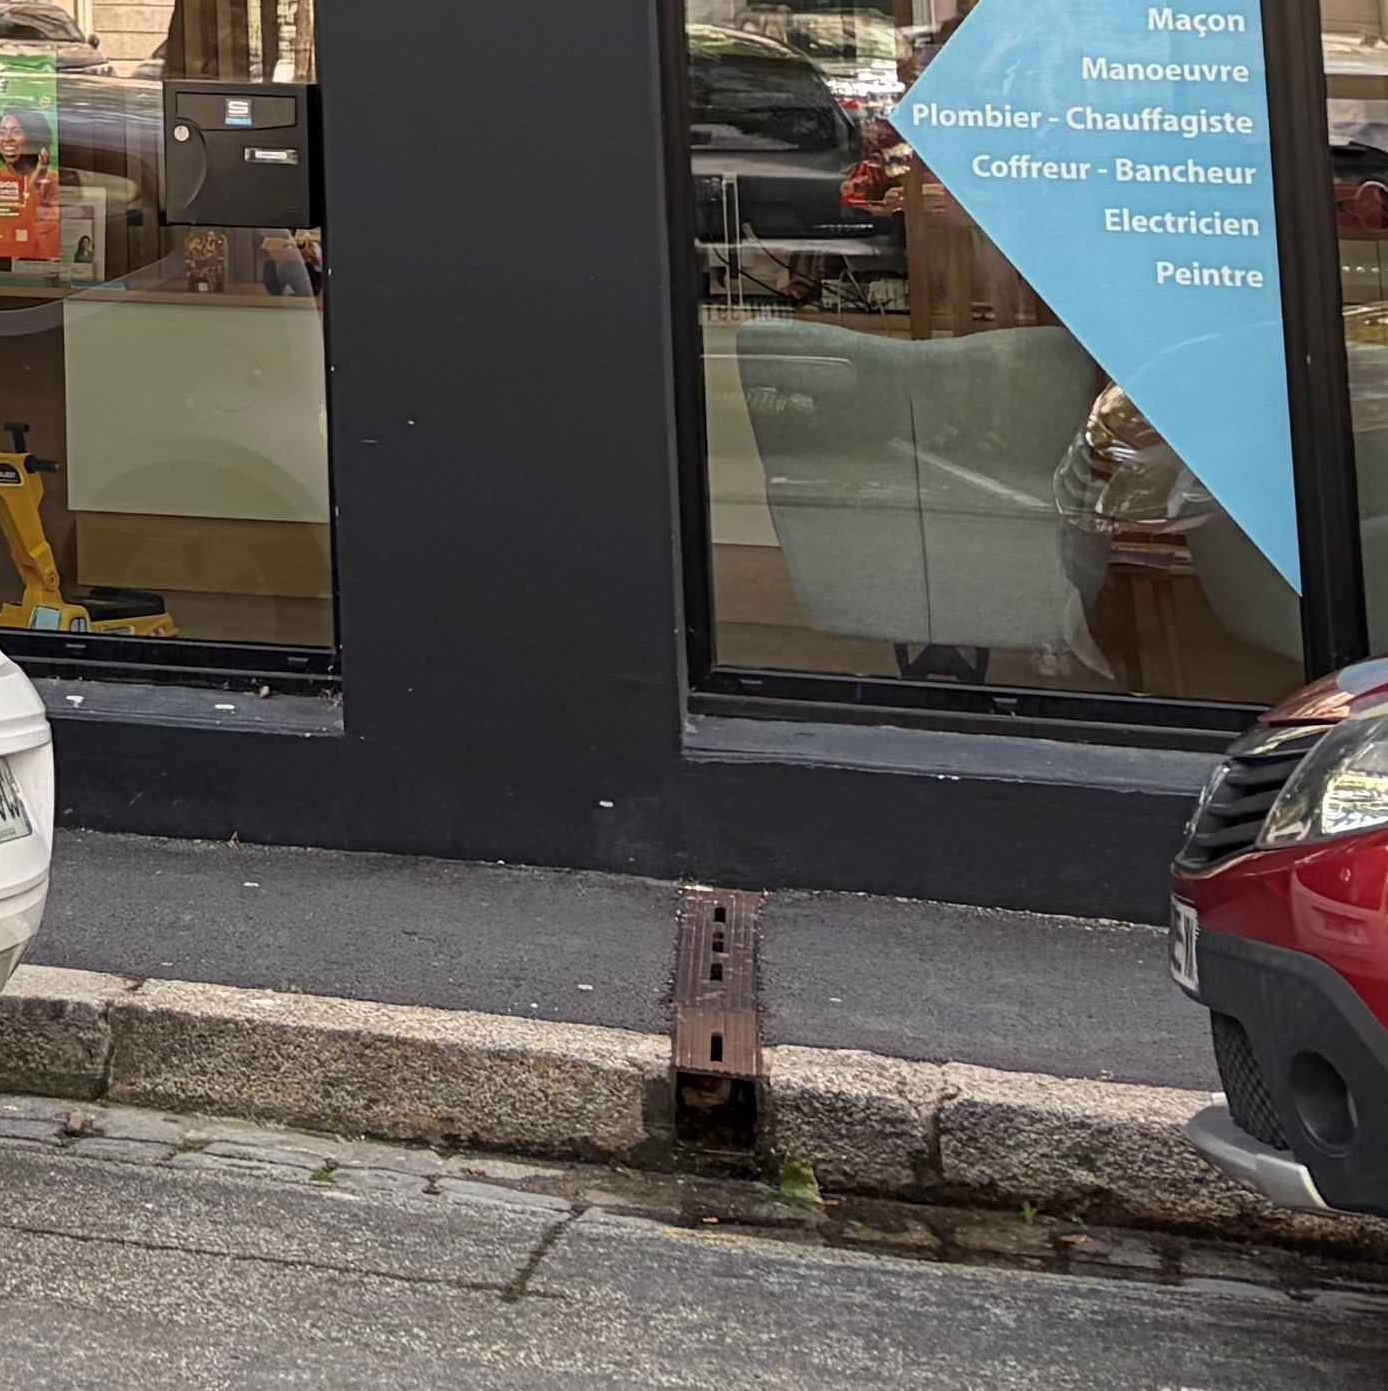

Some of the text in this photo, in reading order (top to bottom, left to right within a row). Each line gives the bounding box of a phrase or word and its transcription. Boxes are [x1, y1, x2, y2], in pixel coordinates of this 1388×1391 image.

[1147, 6, 1246, 38] Maçon
[1081, 56, 1250, 84] Manoeuvre
[912, 104, 1043, 129] Plombier
[1065, 105, 1254, 139] Chauffagiste
[971, 154, 1092, 181] Coffreur
[1115, 158, 1257, 185] Bancheur
[1104, 208, 1260, 237] Electricien
[1156, 261, 1265, 289] Peintre
